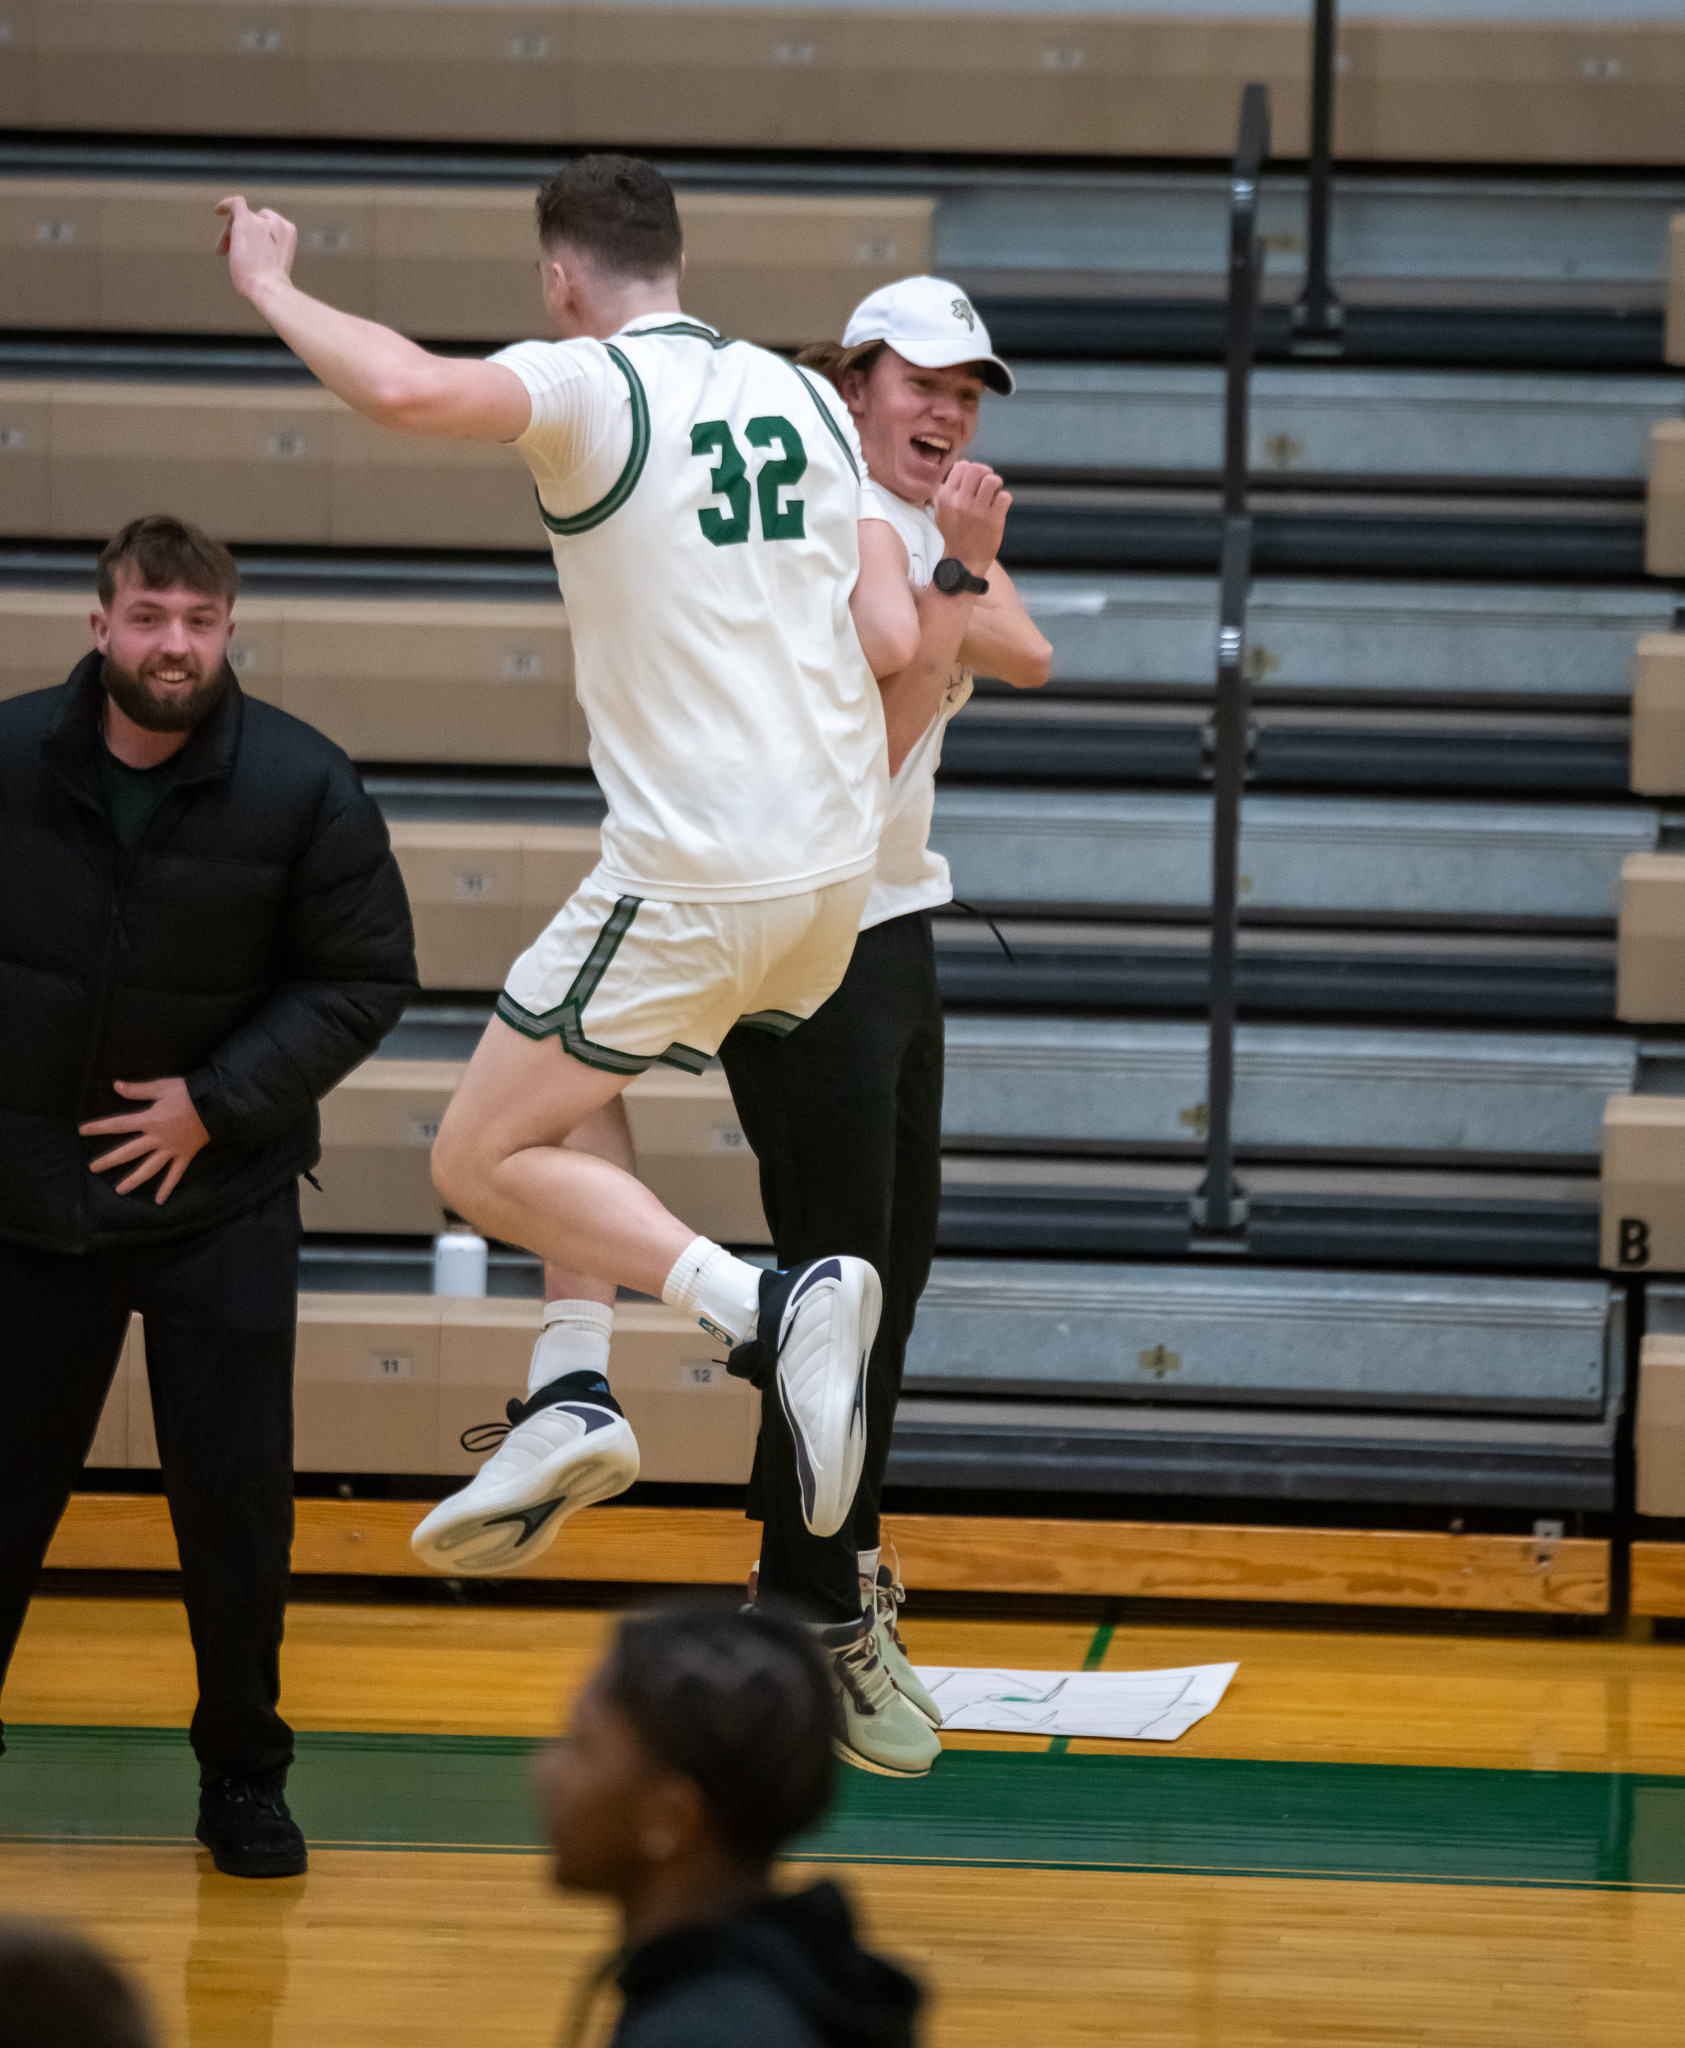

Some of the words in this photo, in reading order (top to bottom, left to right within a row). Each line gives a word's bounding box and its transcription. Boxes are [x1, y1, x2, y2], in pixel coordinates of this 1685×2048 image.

[690, 416, 808, 547] 32
[1619, 1217, 1650, 1267] B
[382, 1359, 399, 1374] 11
[692, 1368, 712, 1383] 12
